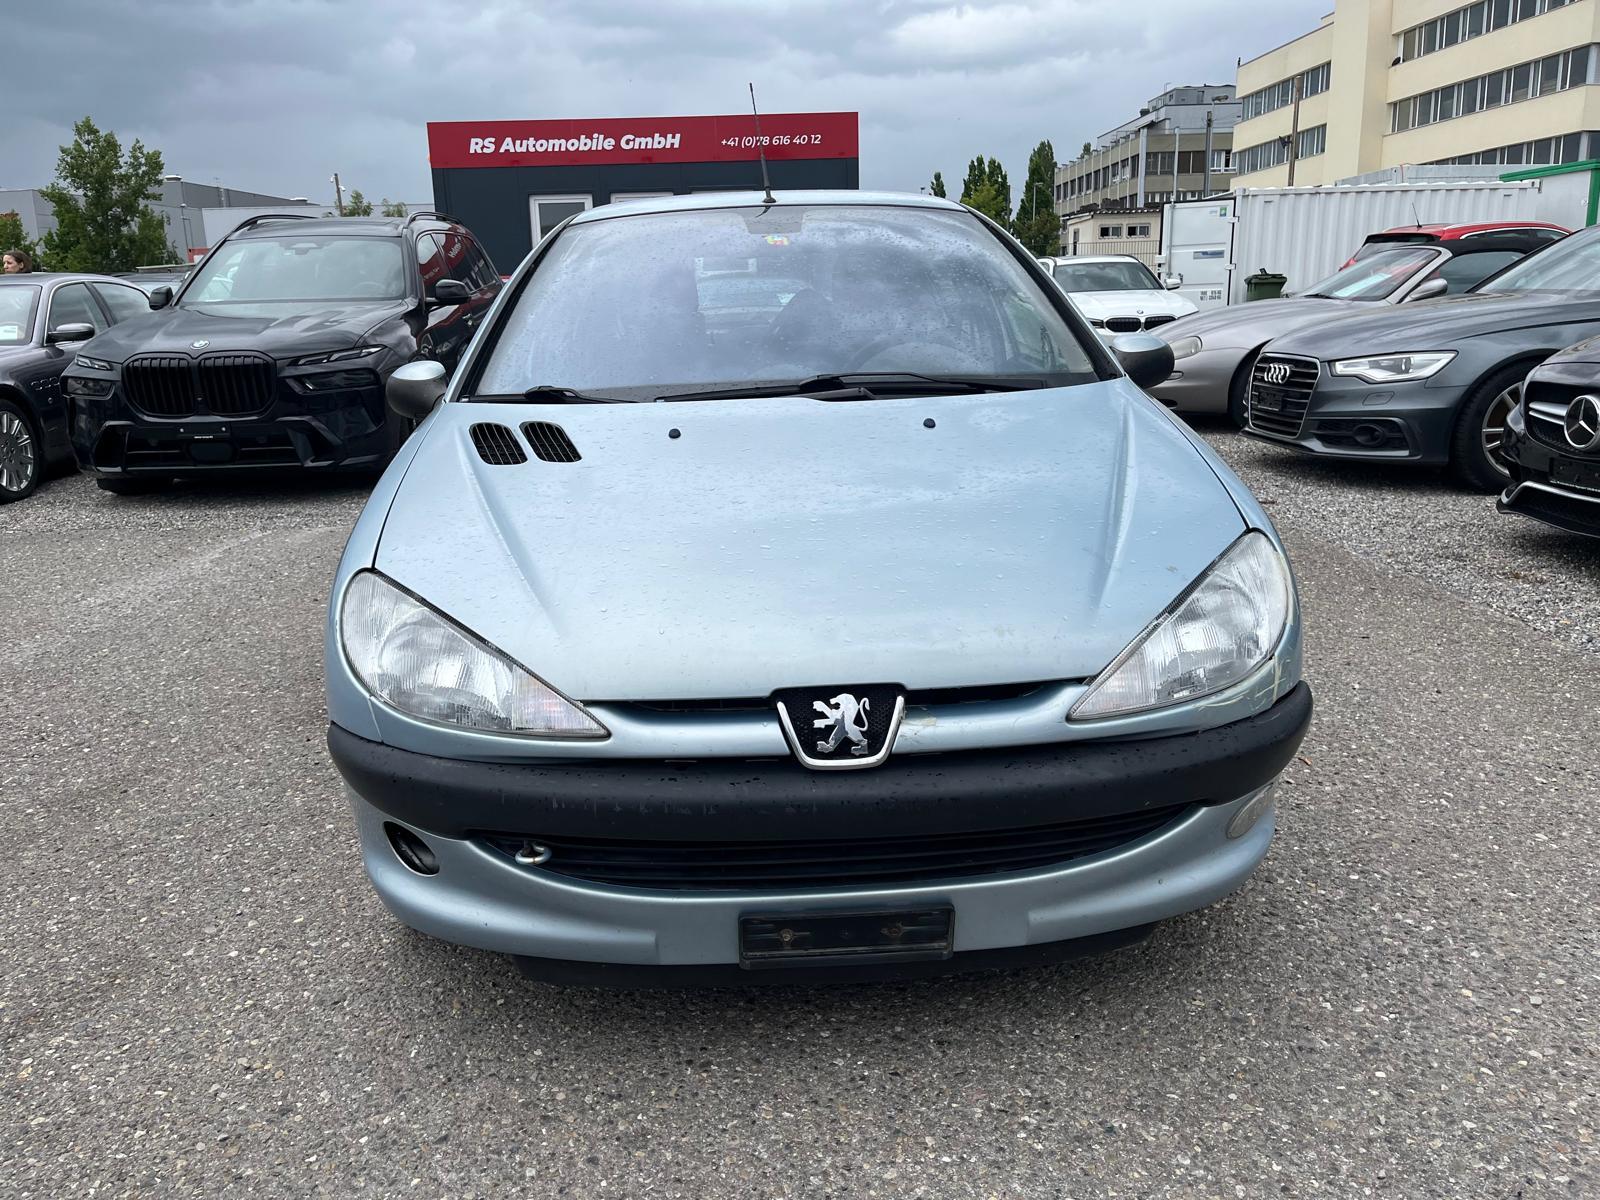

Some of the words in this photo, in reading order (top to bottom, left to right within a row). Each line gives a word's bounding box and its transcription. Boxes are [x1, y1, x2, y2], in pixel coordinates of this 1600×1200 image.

[469, 137, 496, 154] RS
[499, 133, 615, 153] Automobile
[619, 132, 682, 150] GmbH
[720, 137, 739, 147] +41
[772, 135, 791, 146] 616
[793, 135, 809, 145] 40
[810, 134, 822, 144] 12
